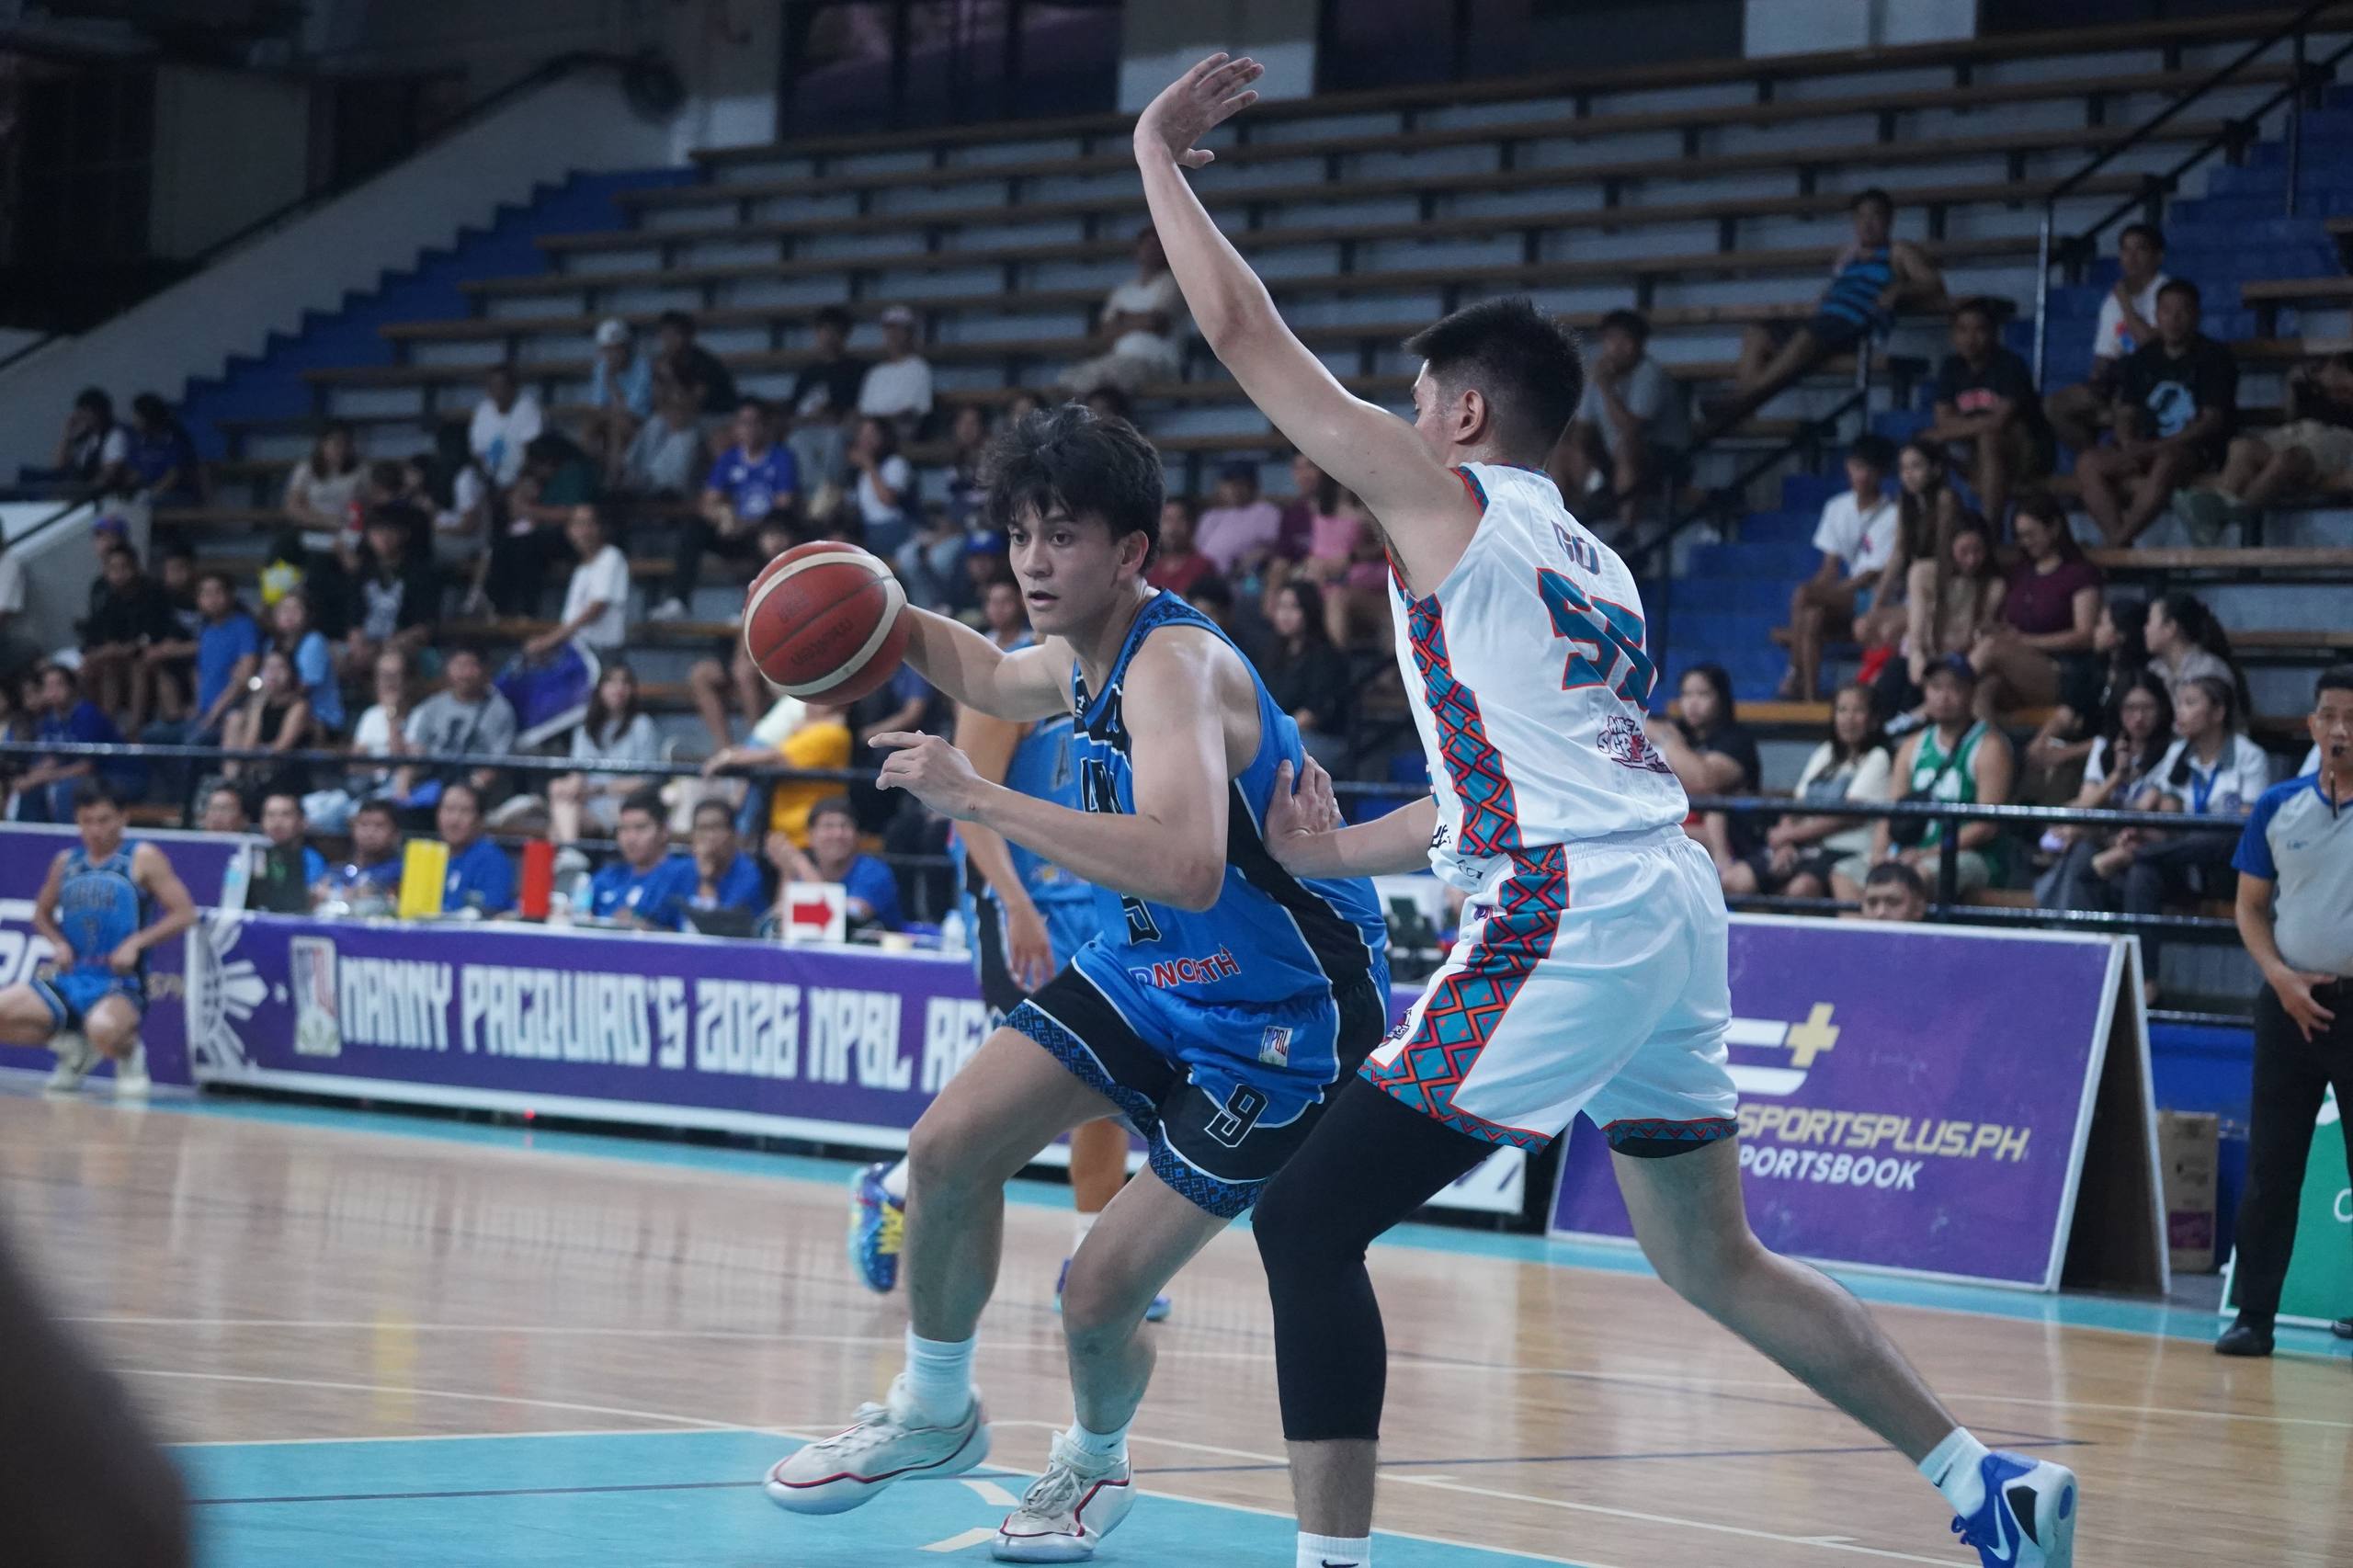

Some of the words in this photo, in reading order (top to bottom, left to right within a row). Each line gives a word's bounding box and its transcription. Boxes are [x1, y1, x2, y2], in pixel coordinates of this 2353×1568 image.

[340, 955, 453, 1051] MANNY
[461, 963, 688, 1070] PACQUIAO'S
[695, 977, 801, 1080] 2026
[807, 986, 912, 1091] MPBL
[1204, 1083, 1268, 1148] 9
[1737, 1104, 2031, 1163] SPORTSPLUS.PH
[1738, 1144, 1924, 1190] PORTSBOOK
